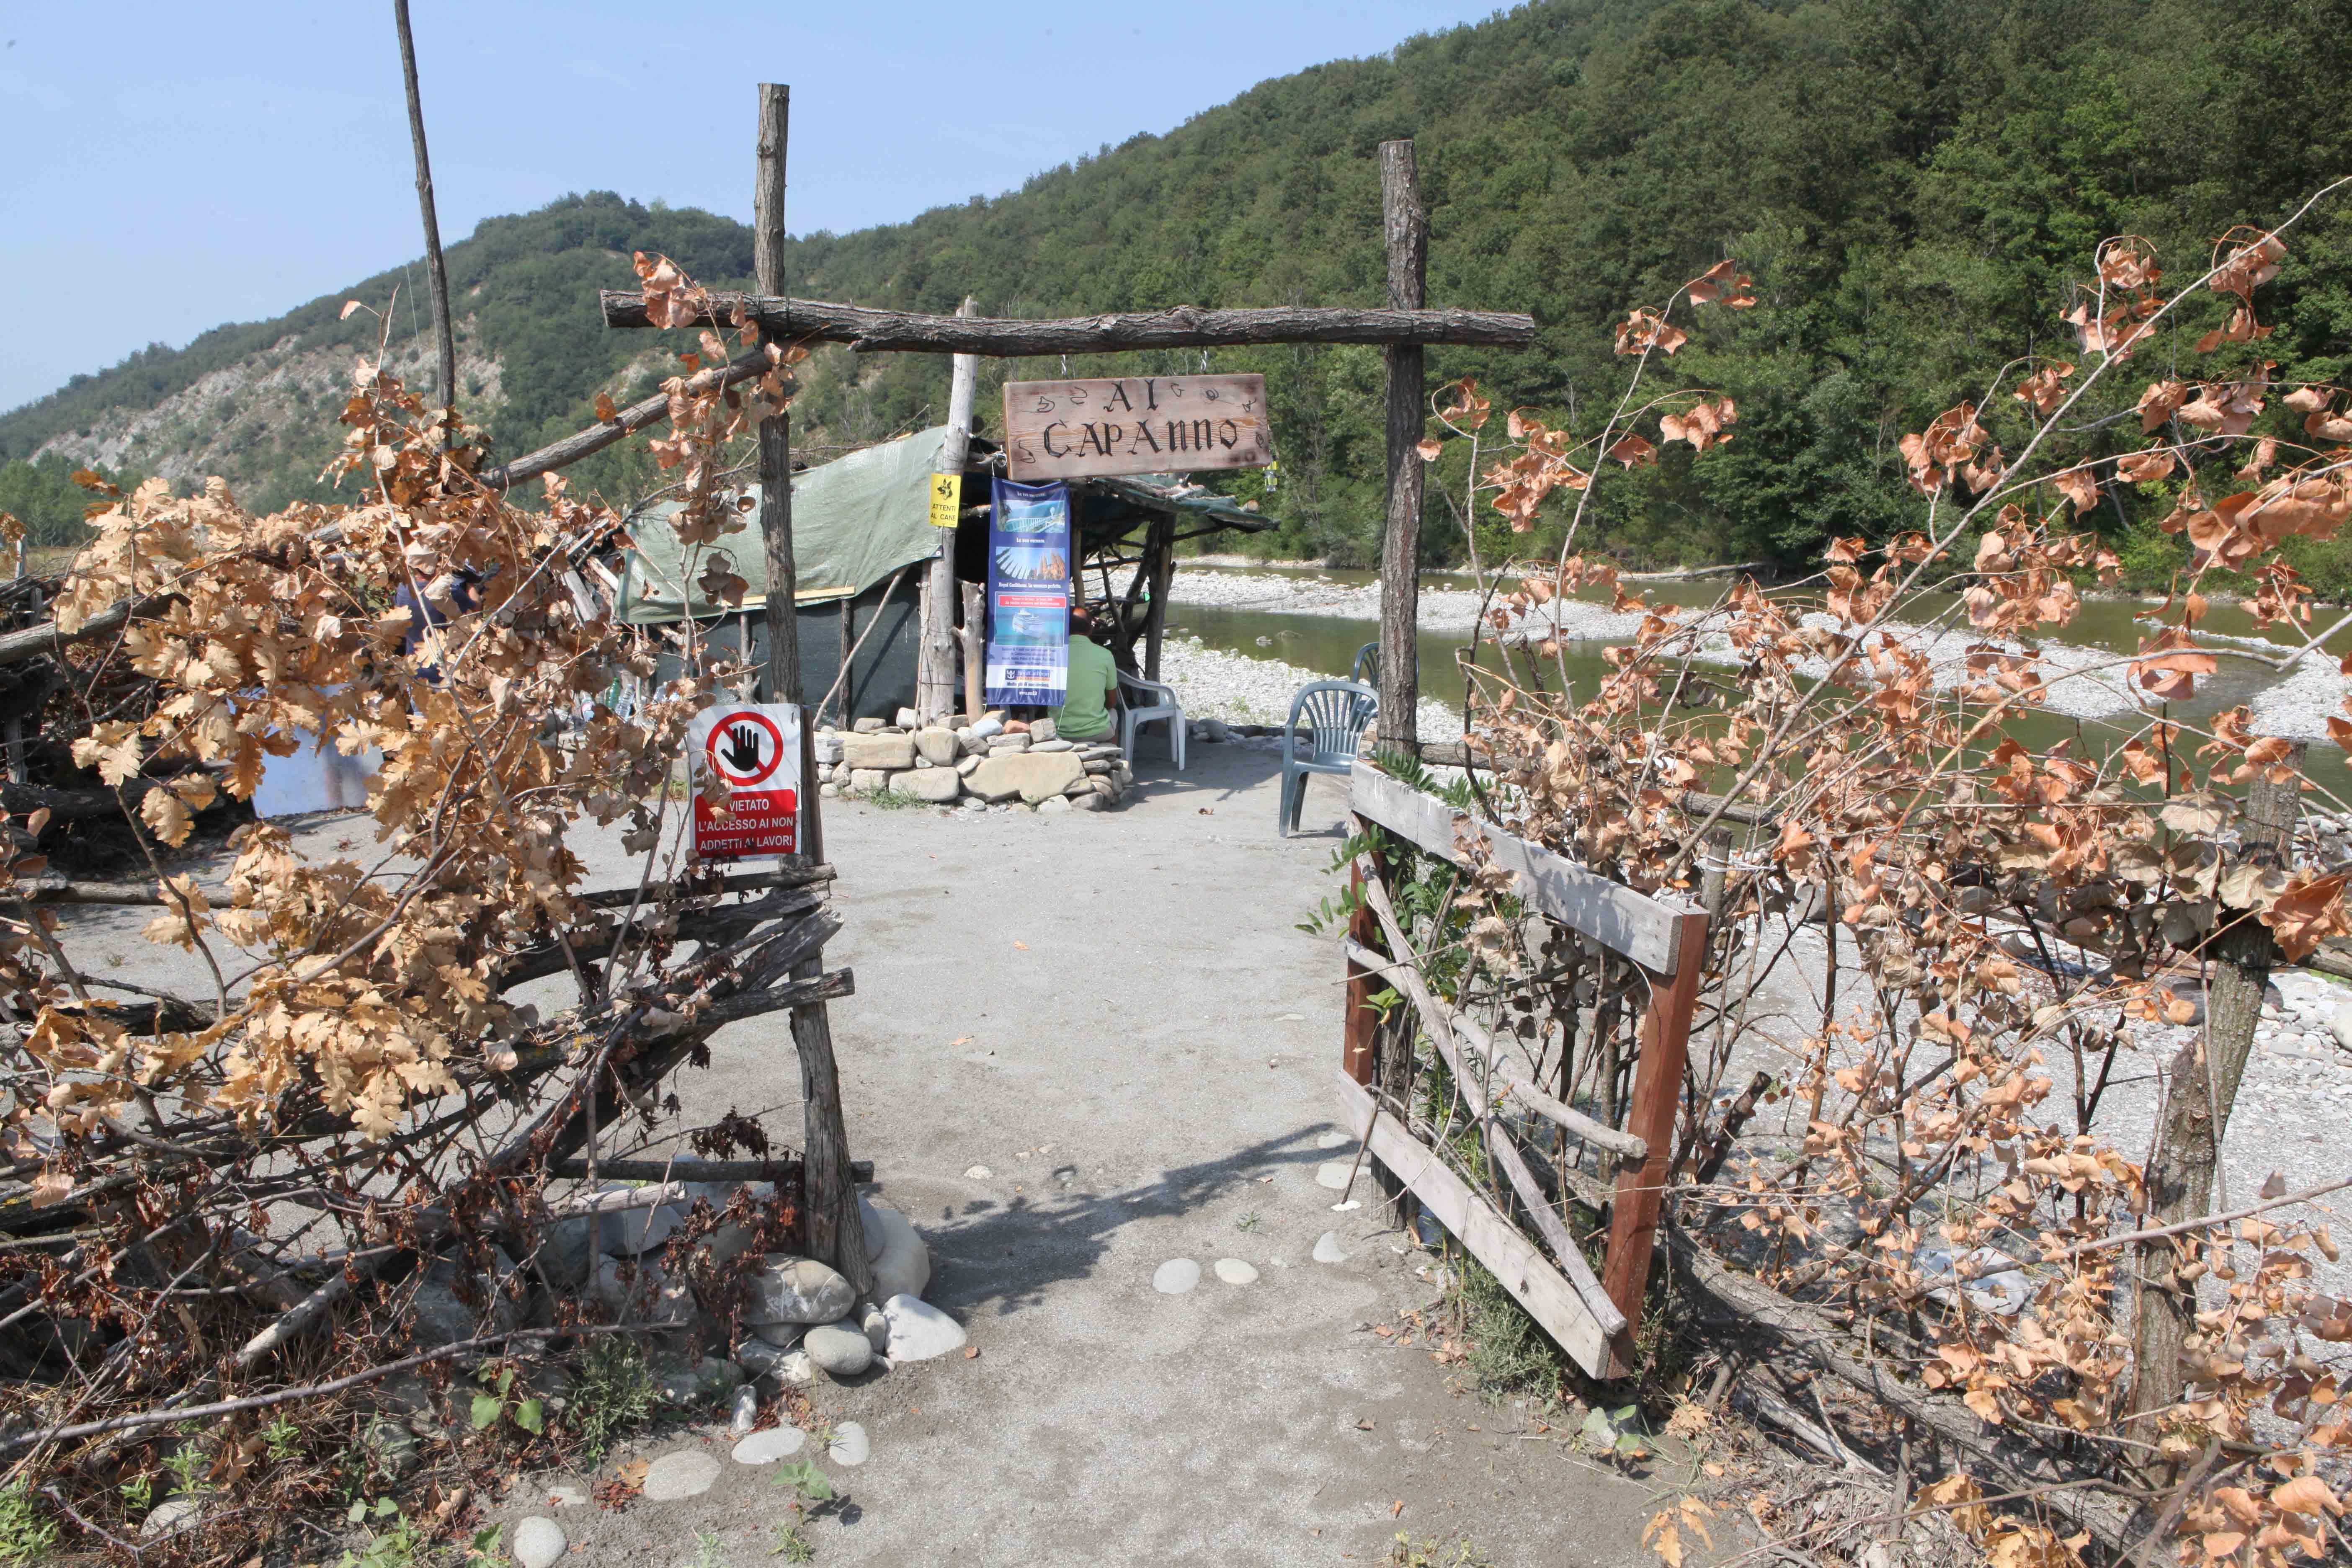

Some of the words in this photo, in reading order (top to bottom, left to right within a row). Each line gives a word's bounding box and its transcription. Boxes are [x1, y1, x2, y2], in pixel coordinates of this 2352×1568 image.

[730, 799, 769, 811] VIETATO
[699, 819, 756, 832] L'ACCESSO
[759, 818, 769, 828] AI
[772, 817, 793, 827] NON
[700, 838, 743, 851] ADDETTI
[757, 835, 792, 847] LAVORI
